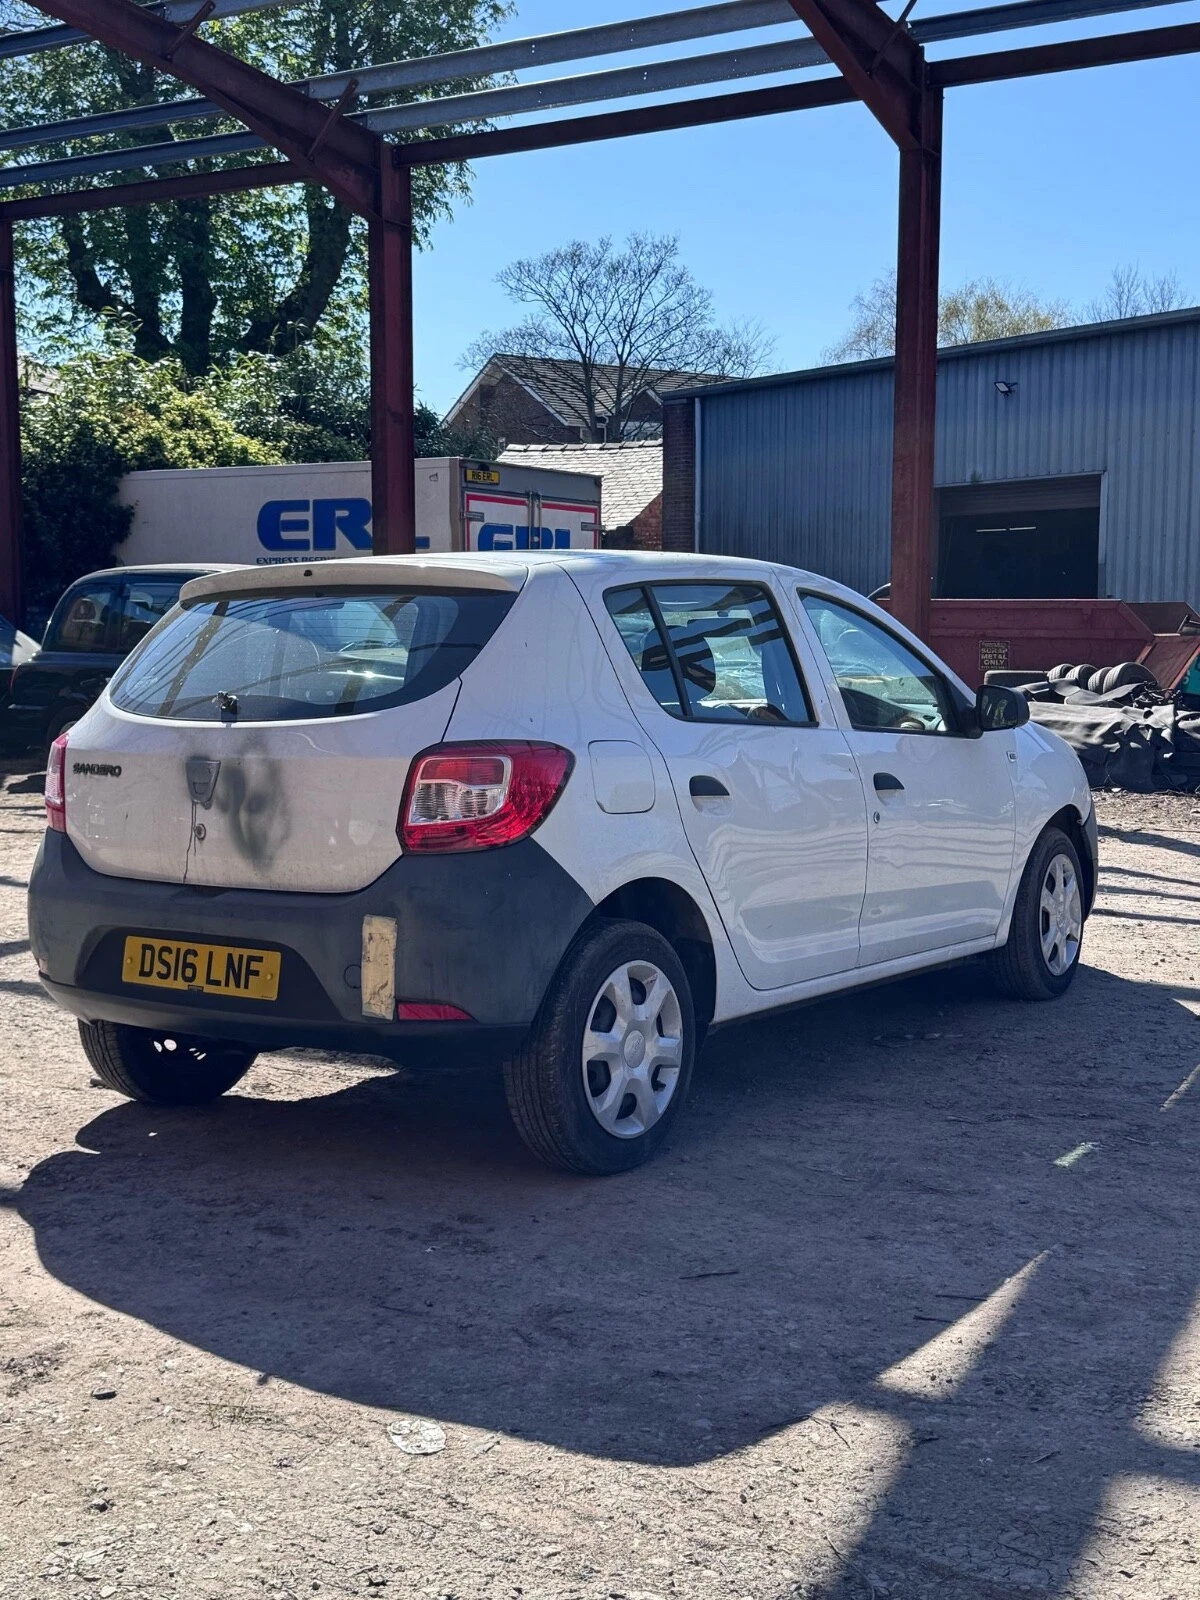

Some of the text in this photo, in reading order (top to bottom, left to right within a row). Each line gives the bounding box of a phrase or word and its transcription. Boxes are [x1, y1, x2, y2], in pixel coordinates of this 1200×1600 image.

[483, 472, 495, 482] ERL
[257, 498, 430, 551] ER
[73, 763, 122, 777] SANDERO
[138, 944, 264, 990] DS16 LNF
